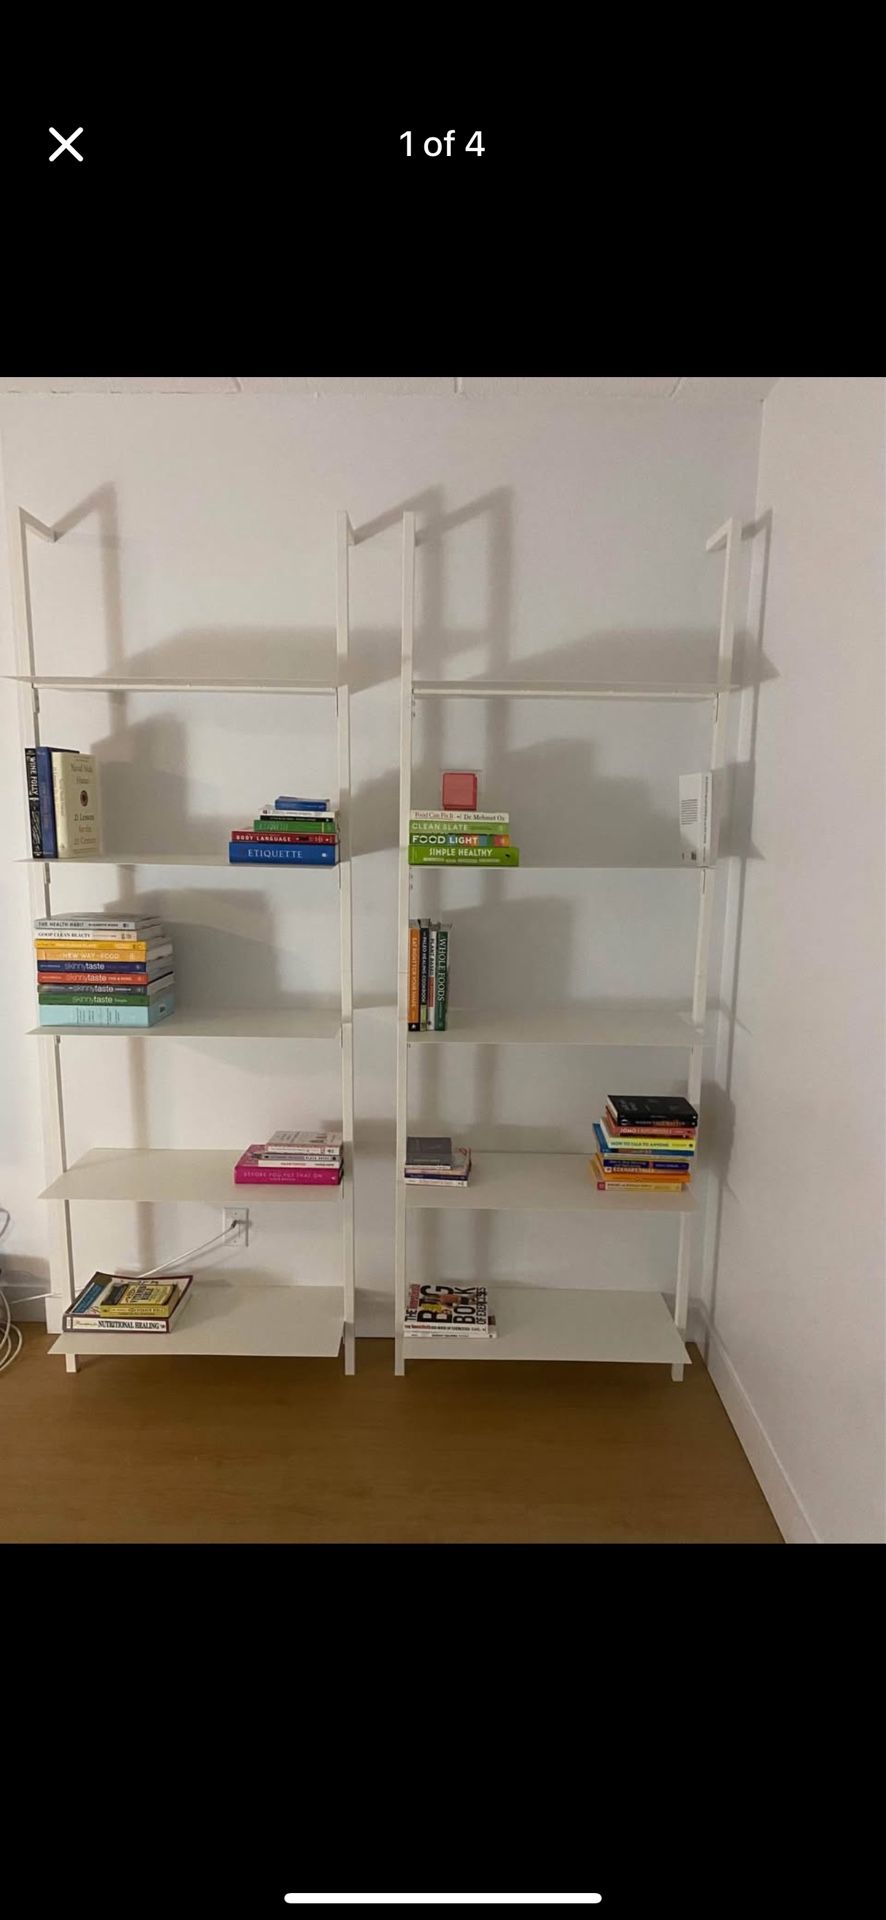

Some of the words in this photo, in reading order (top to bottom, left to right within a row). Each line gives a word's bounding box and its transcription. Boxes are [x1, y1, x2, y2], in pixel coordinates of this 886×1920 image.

[30, 756, 38, 774] WINE
[31, 776, 39, 796] FOLLY
[412, 835, 446, 844] FOOD
[449, 836, 479, 845] LIGHT
[247, 849, 303, 859] ETIQUETTE
[429, 848, 456, 856] SIMPLE
[458, 849, 493, 857] HEALTHY
[438, 938, 447, 971] WHOLE
[64, 962, 105, 972] skinnytaste
[66, 974, 107, 984] skinnytaste
[72, 985, 114, 994] skinnytaste
[437, 973, 446, 1001] FOODS
[71, 996, 113, 1004] skinnytaste
[417, 1285, 455, 1323] BIG
[453, 1287, 476, 1324] BOK
[476, 1287, 488, 1317] EXERCISES
[405, 1306, 418, 1322] THE
[98, 1321, 134, 1329] NUTRITIONAL
[135, 1321, 160, 1330] HEALING
